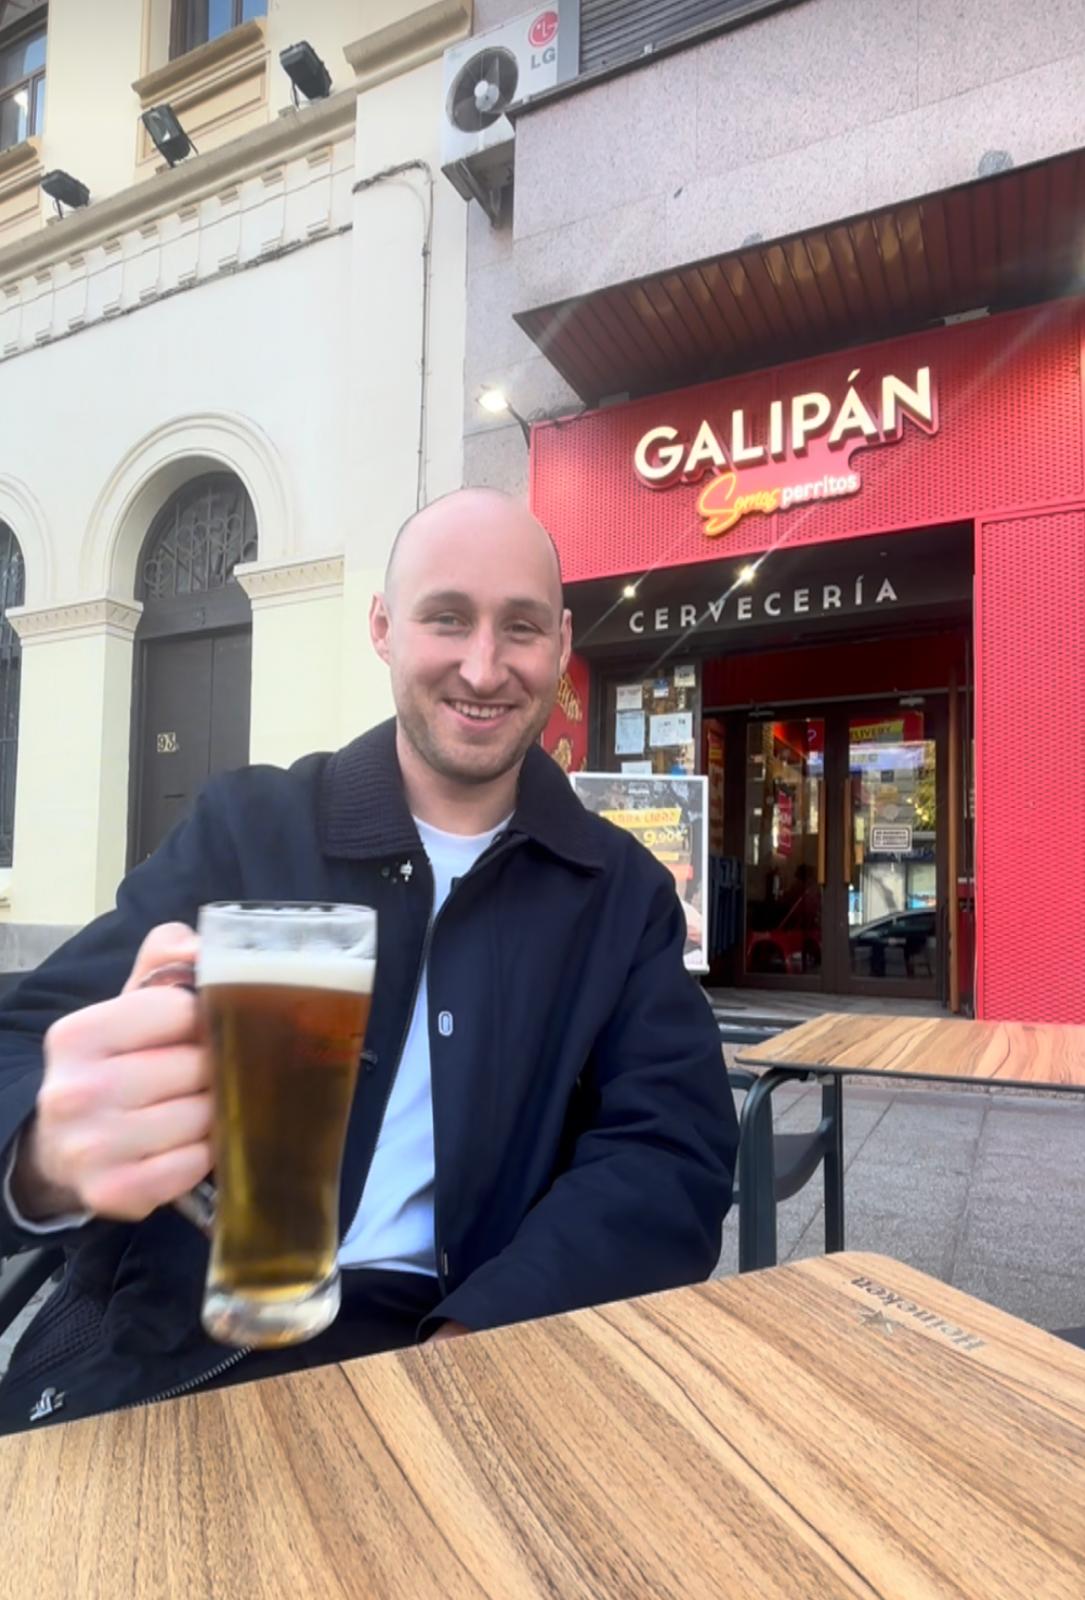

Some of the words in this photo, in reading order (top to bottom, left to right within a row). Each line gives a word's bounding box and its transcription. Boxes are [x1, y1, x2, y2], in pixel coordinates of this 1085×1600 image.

[530, 47, 556, 69] LG
[634, 366, 931, 480] GALIPÁN
[698, 472, 781, 536] Somos
[782, 473, 858, 506] perritos
[629, 575, 898, 633] CERVECERÍA
[851, 1276, 987, 1351] Heineken
